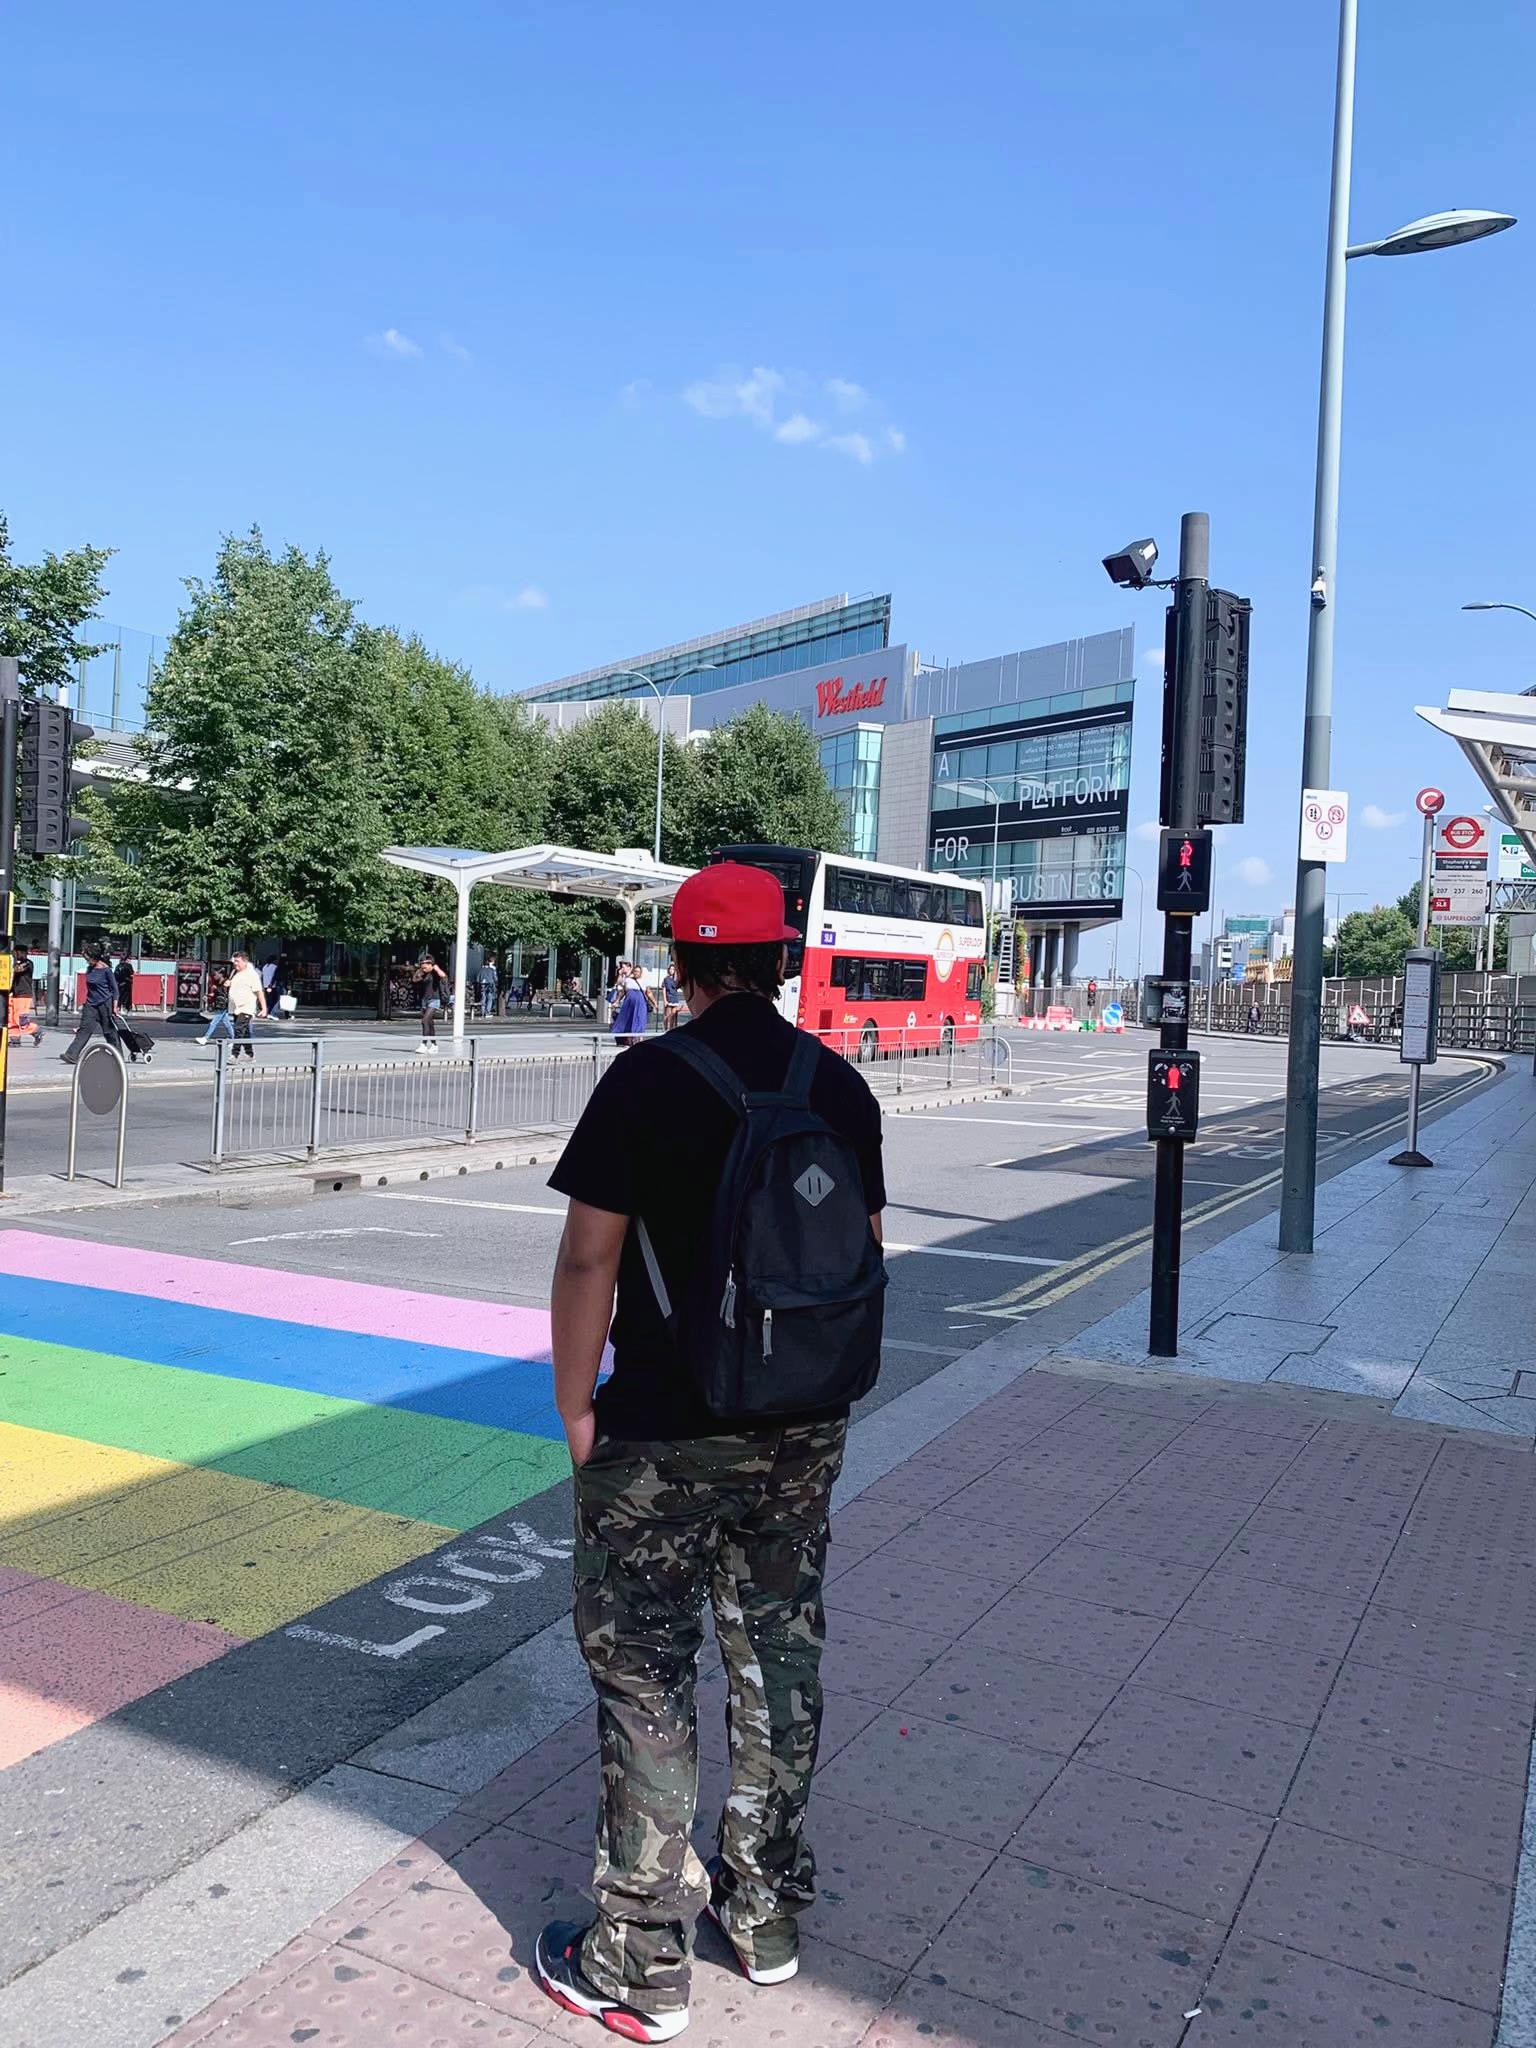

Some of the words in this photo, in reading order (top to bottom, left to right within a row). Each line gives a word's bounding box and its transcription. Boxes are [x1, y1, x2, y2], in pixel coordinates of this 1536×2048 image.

[816, 676, 887, 718] Westfield
[938, 754, 950, 777] A
[1019, 774, 1119, 811] PLATFORM
[1420, 791, 1440, 811] C
[934, 836, 969, 863] FOR
[1010, 869, 1117, 901] BUSINESS
[1436, 887, 1448, 895] 207
[283, 1521, 577, 1660] LOOK
